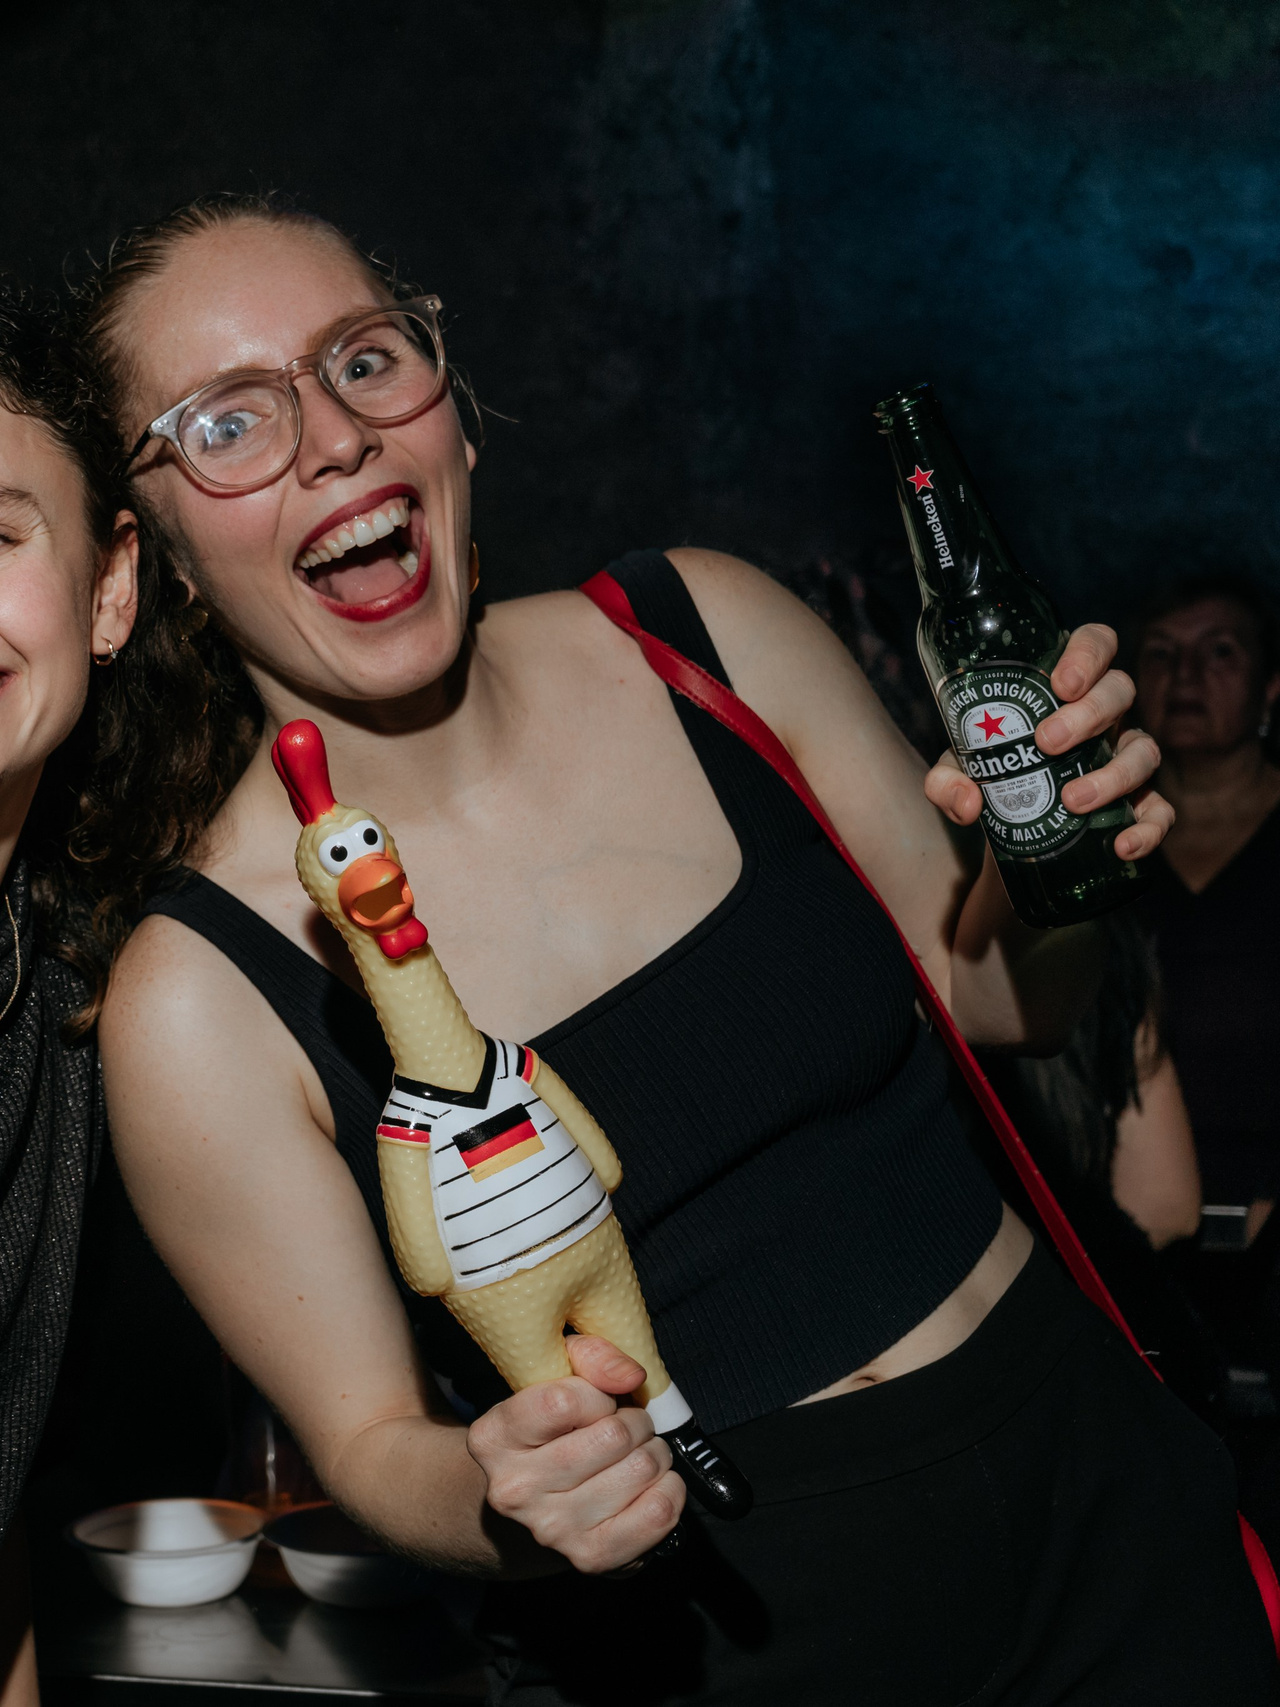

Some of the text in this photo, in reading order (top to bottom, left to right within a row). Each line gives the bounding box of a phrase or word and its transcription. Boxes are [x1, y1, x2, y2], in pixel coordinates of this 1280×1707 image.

[922, 493, 955, 570] Heineken
[948, 687, 979, 739] HEINEKEN
[982, 682, 1048, 718] ORIGINAL
[960, 743, 1045, 778] Heinek
[982, 808, 1008, 839] PURE
[1012, 823, 1047, 842] MALT
